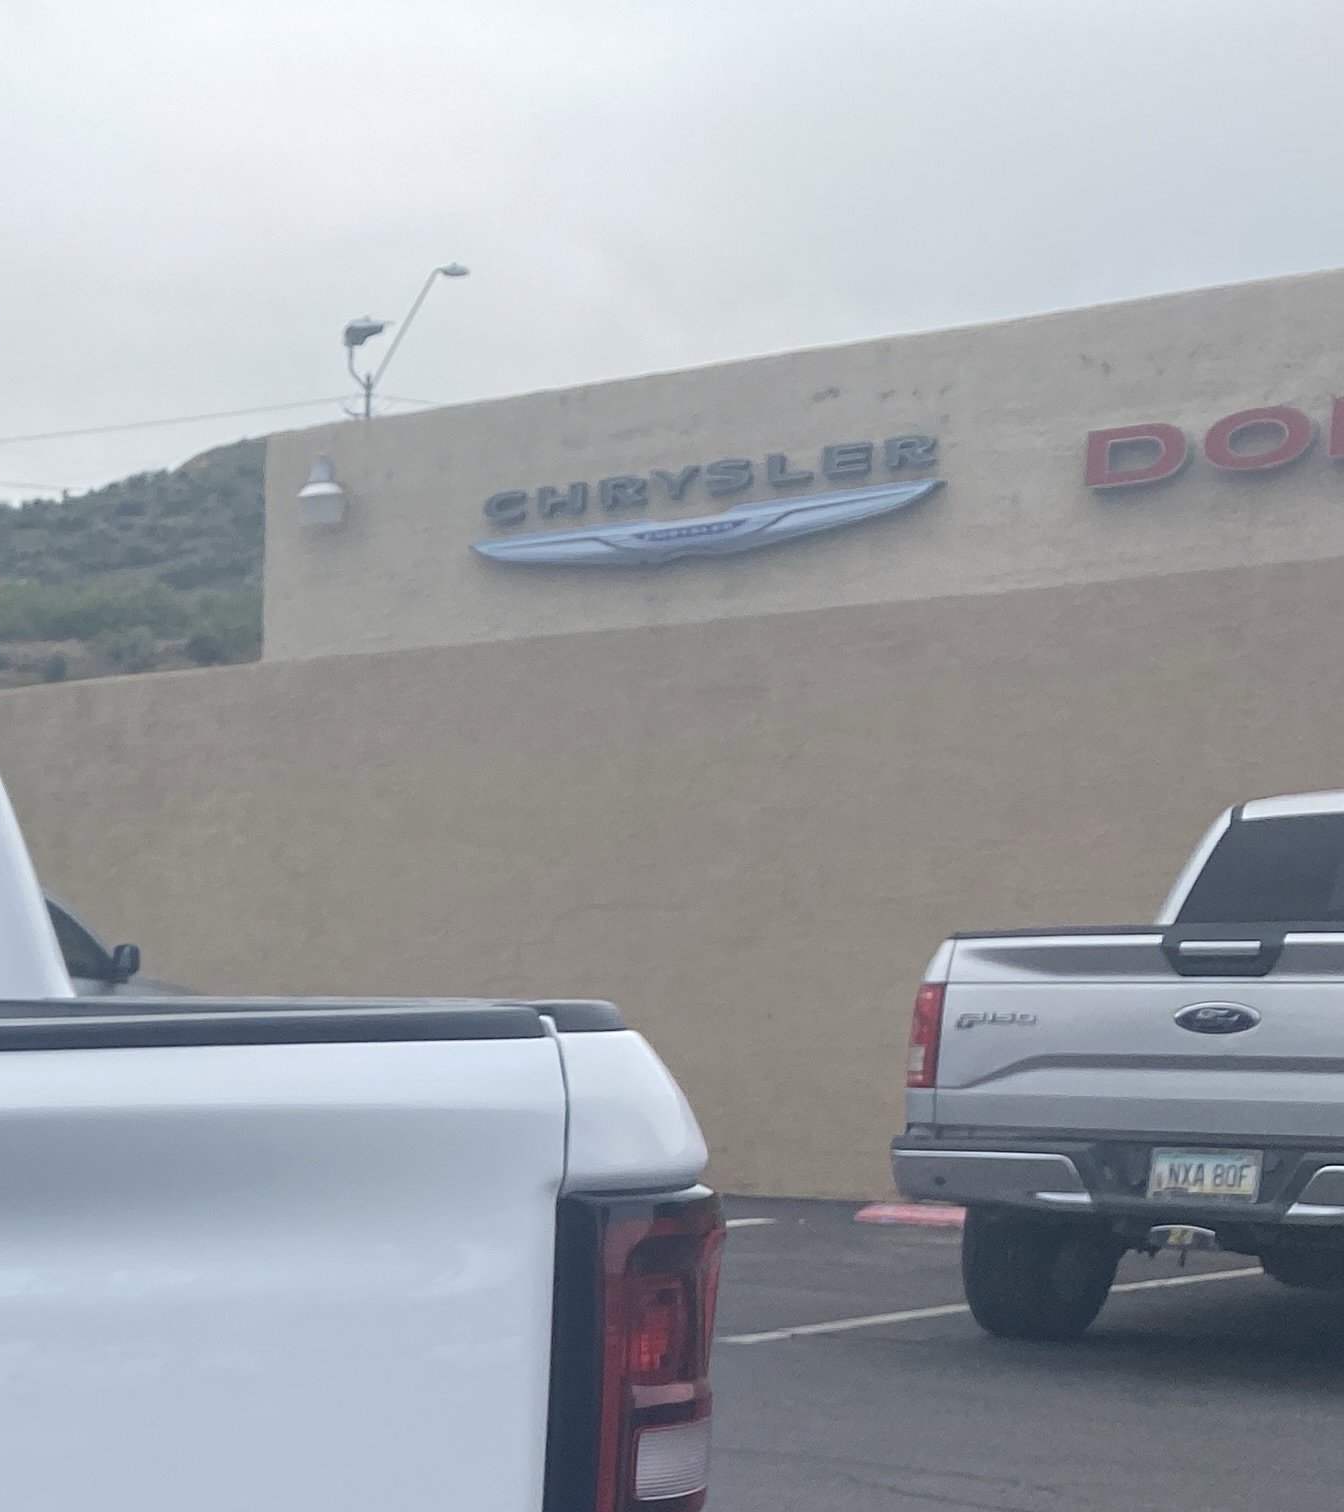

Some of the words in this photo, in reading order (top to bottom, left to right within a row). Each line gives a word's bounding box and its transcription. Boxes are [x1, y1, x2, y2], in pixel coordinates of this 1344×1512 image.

[484, 434, 938, 521] CHRYSLER
[1084, 395, 1344, 487] DO
[1169, 1162, 1205, 1185] NXA
